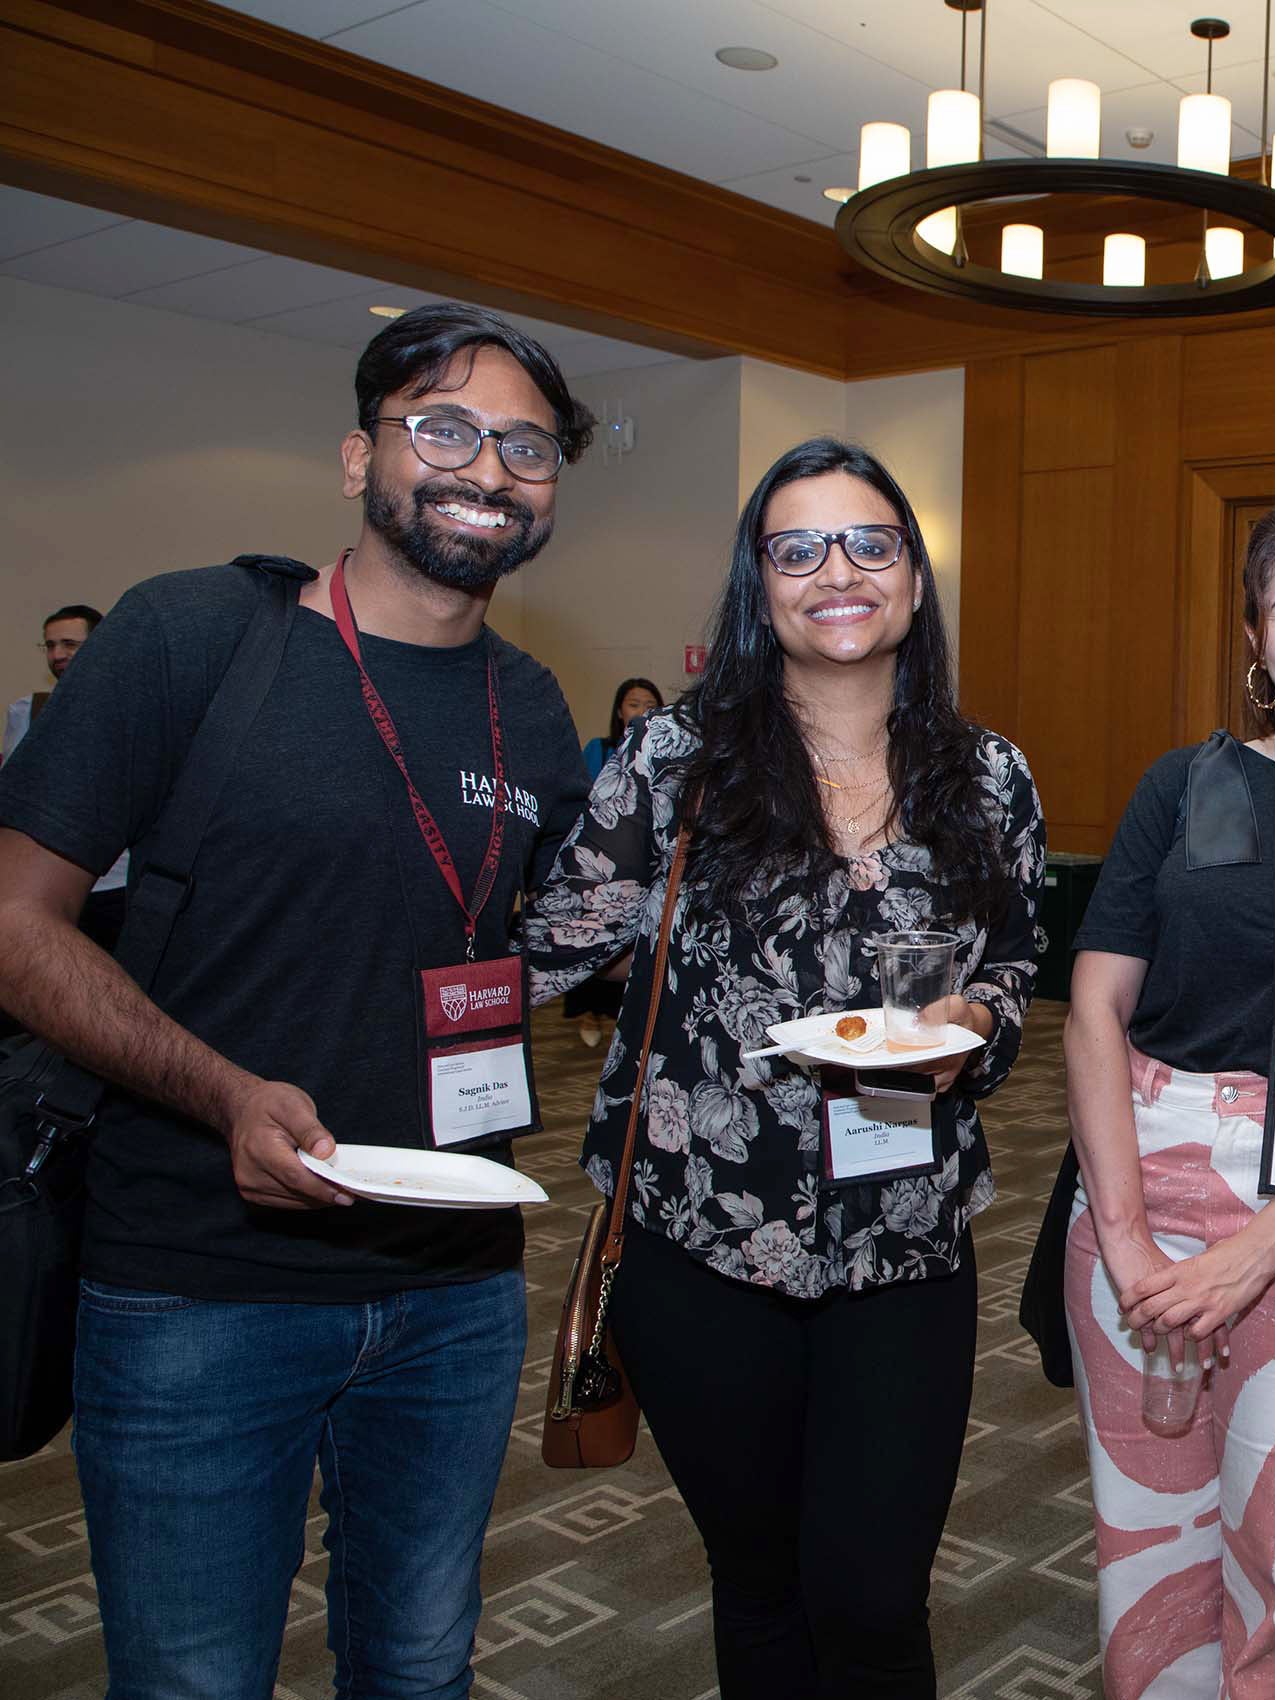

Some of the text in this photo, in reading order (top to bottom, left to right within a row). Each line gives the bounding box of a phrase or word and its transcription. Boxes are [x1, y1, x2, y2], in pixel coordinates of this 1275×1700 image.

[460, 770, 538, 812] HAARD
[463, 790, 495, 808] LAW
[469, 985, 511, 1002] HARVARD
[470, 997, 510, 1010] LAW SCHOOL
[458, 1081, 509, 1096] Sagnik Das
[844, 1122, 882, 1137] Aarushi
